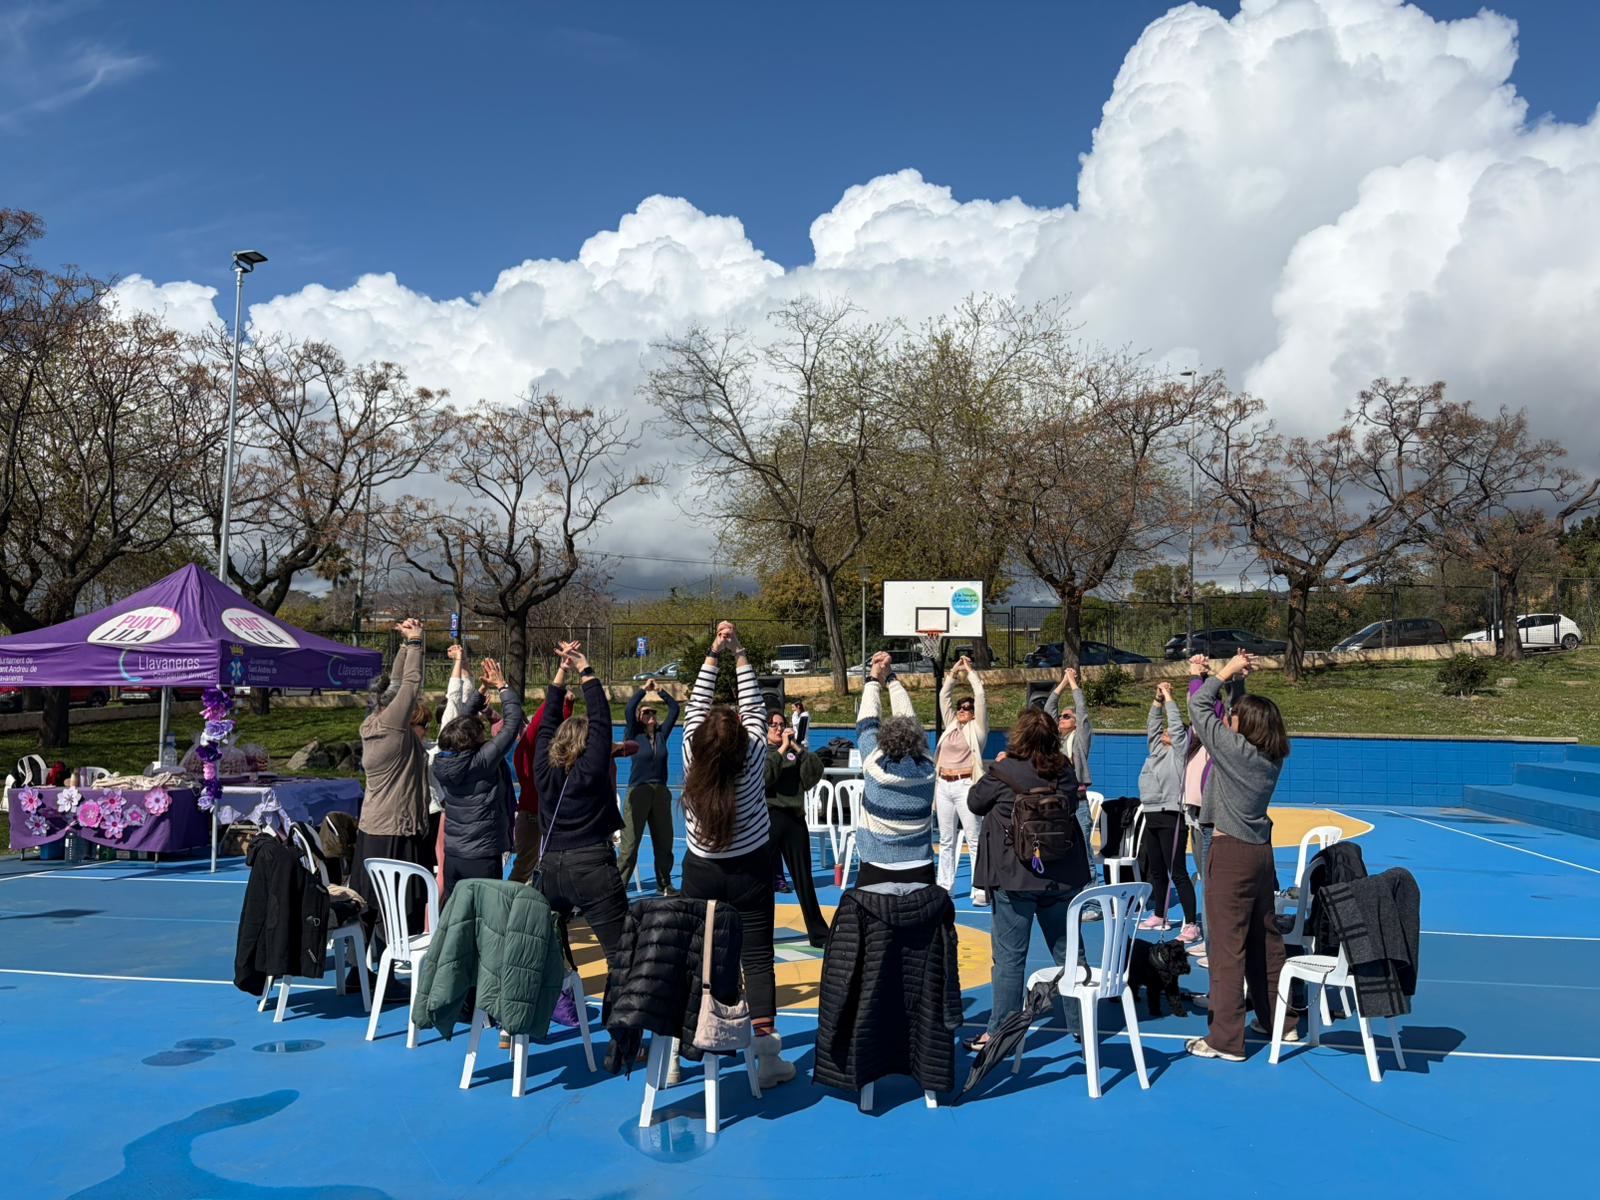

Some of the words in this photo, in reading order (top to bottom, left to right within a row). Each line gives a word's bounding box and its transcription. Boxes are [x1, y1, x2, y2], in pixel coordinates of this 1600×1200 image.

[117, 615, 169, 629] PUNT
[228, 617, 268, 630] PUNT
[97, 628, 151, 641] LILA
[244, 630, 289, 644] LILA
[9, 665, 28, 673] Andreu
[30, 665, 37, 673] de
[138, 655, 200, 670] Llavaneres
